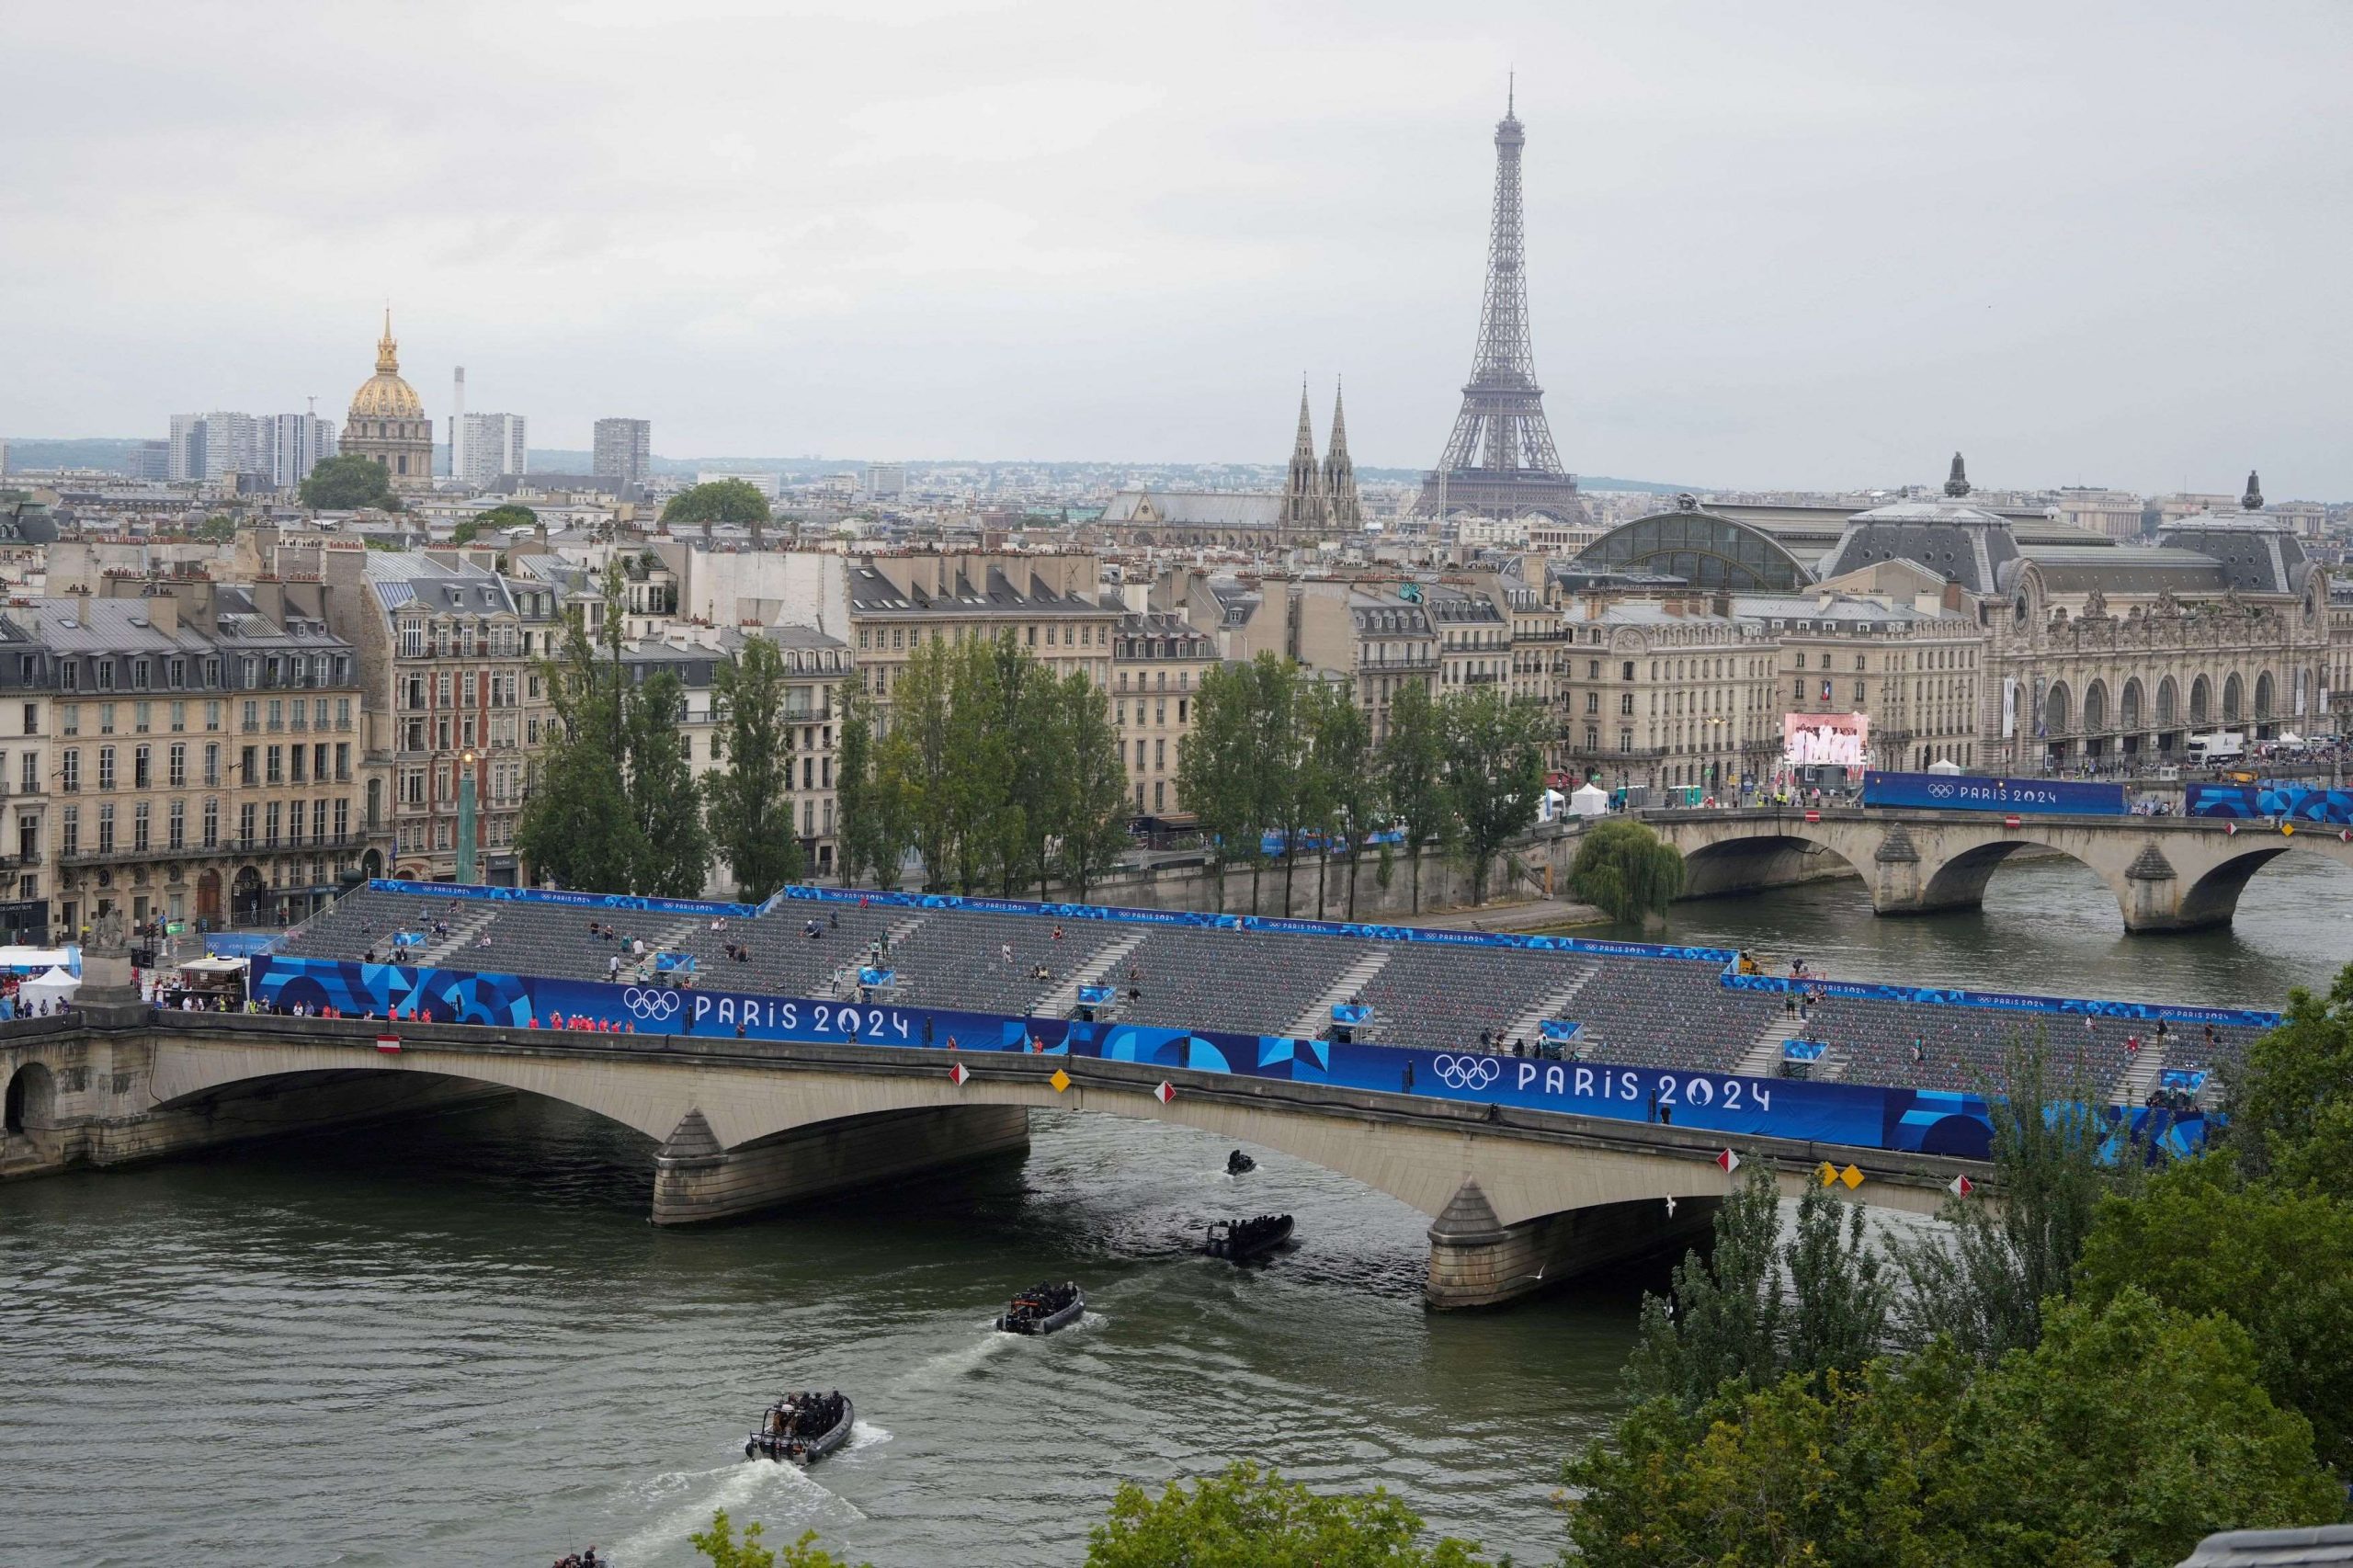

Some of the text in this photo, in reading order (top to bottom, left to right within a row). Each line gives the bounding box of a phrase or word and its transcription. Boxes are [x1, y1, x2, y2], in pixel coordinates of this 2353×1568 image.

[2014, 790, 2056, 803] 2024
[1844, 986, 1866, 994] 2024
[2021, 999, 2044, 1007] 2024
[2205, 1012, 2229, 1020] 2024
[813, 1006, 908, 1040] 2024
[1658, 1075, 1769, 1112] 2024
